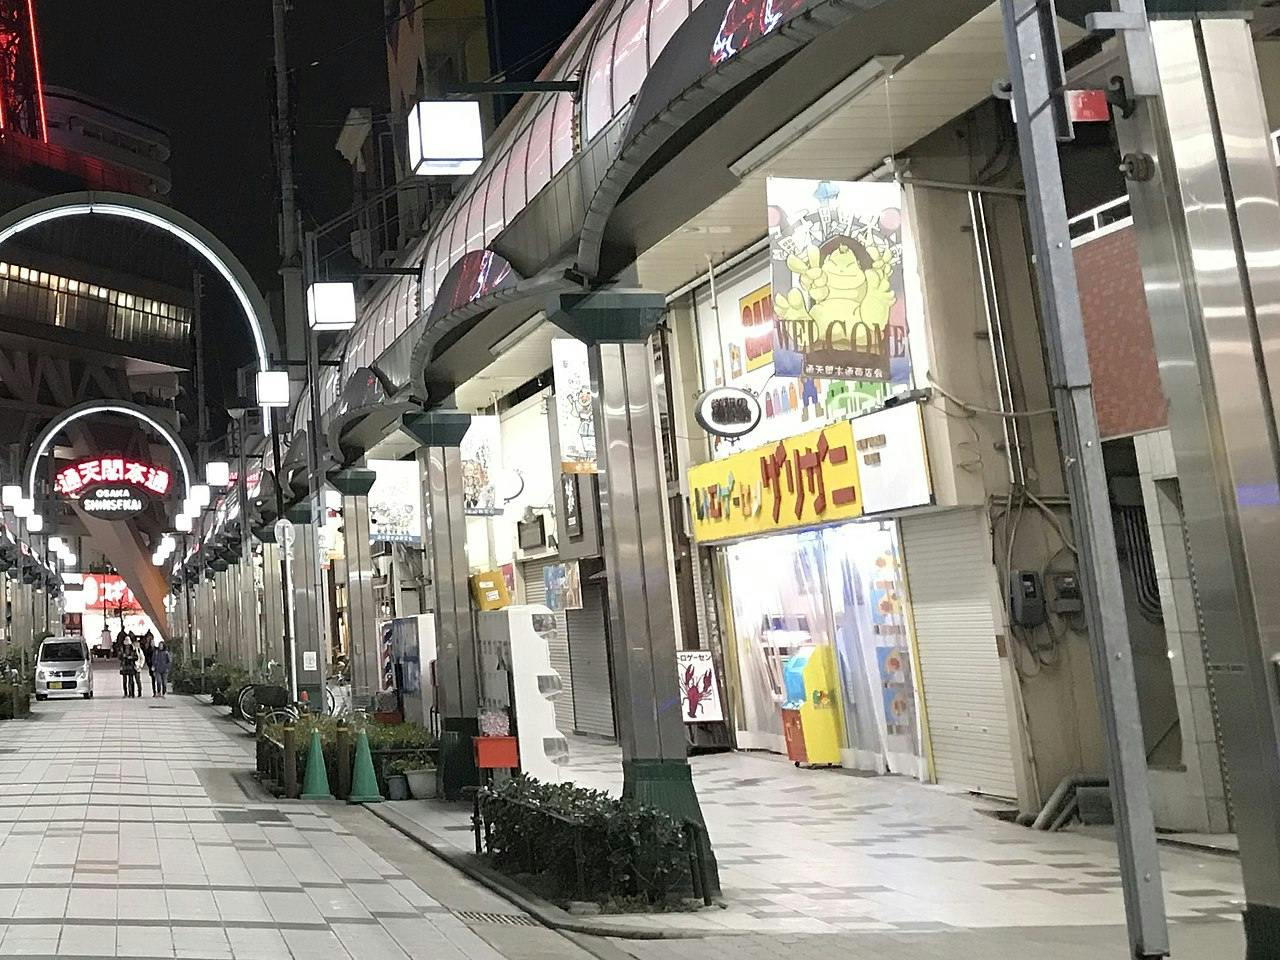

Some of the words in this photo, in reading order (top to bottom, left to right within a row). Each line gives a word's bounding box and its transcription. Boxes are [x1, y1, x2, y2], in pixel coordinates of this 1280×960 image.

[776, 319, 907, 358] WELCOME
[760, 429, 856, 524] ザリガニ
[83, 499, 142, 511] SHINSEKAI
[95, 489, 130, 498] OSAKA
